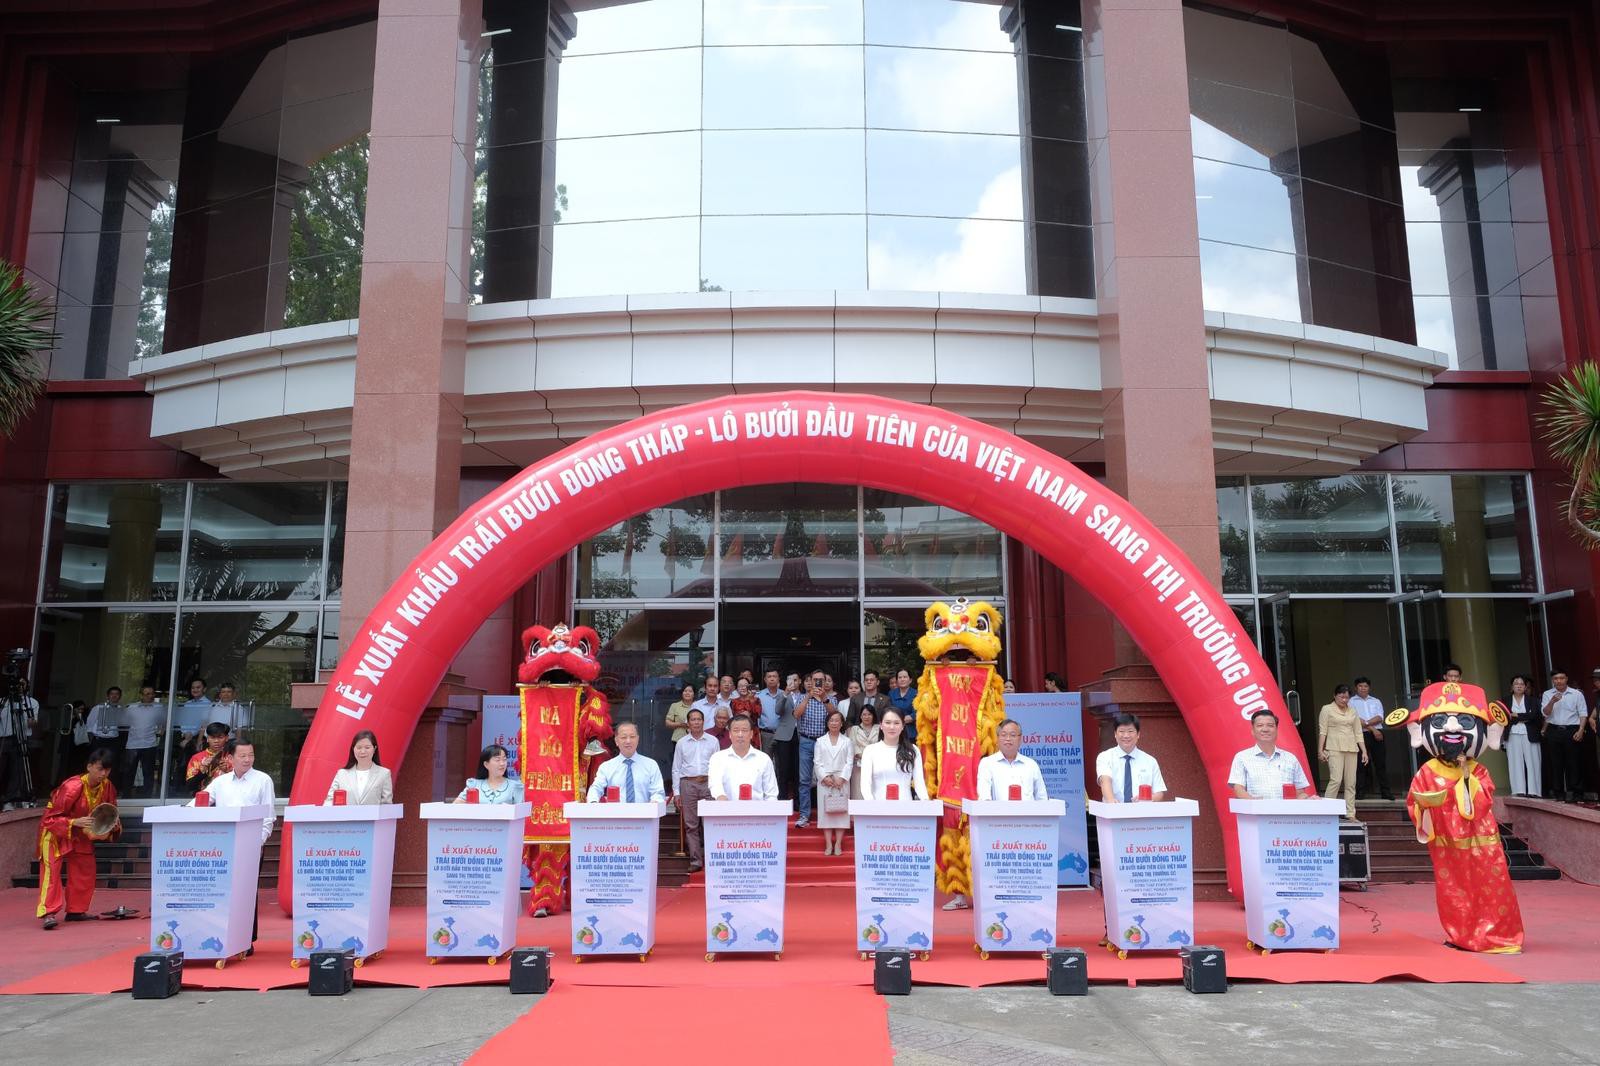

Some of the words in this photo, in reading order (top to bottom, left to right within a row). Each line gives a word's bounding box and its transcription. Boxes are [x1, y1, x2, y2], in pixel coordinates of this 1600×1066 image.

[707, 409, 738, 443] LÔ
[744, 401, 799, 439] BƯỞI
[805, 402, 855, 439] ĐẦU
[865, 413, 918, 449] TIÊN
[625, 422, 689, 465] THÁP
[922, 425, 969, 463] CỦA
[974, 439, 1026, 483] VIỆT
[559, 447, 627, 497] ĐỒNG
[1025, 465, 1088, 516] NAM
[498, 476, 561, 532] BƯỞI
[449, 516, 508, 570] TRÁI
[1085, 504, 1150, 565] SANG
[396, 560, 459, 627] KHẨU
[1142, 554, 1186, 603] THỊ
[353, 621, 409, 687] XUẤT
[1174, 590, 1251, 686] TRƯỜNG
[335, 681, 373, 721] LỄ
[951, 702, 971, 727] SỰ
[1022, 731, 1041, 743] UẤT
